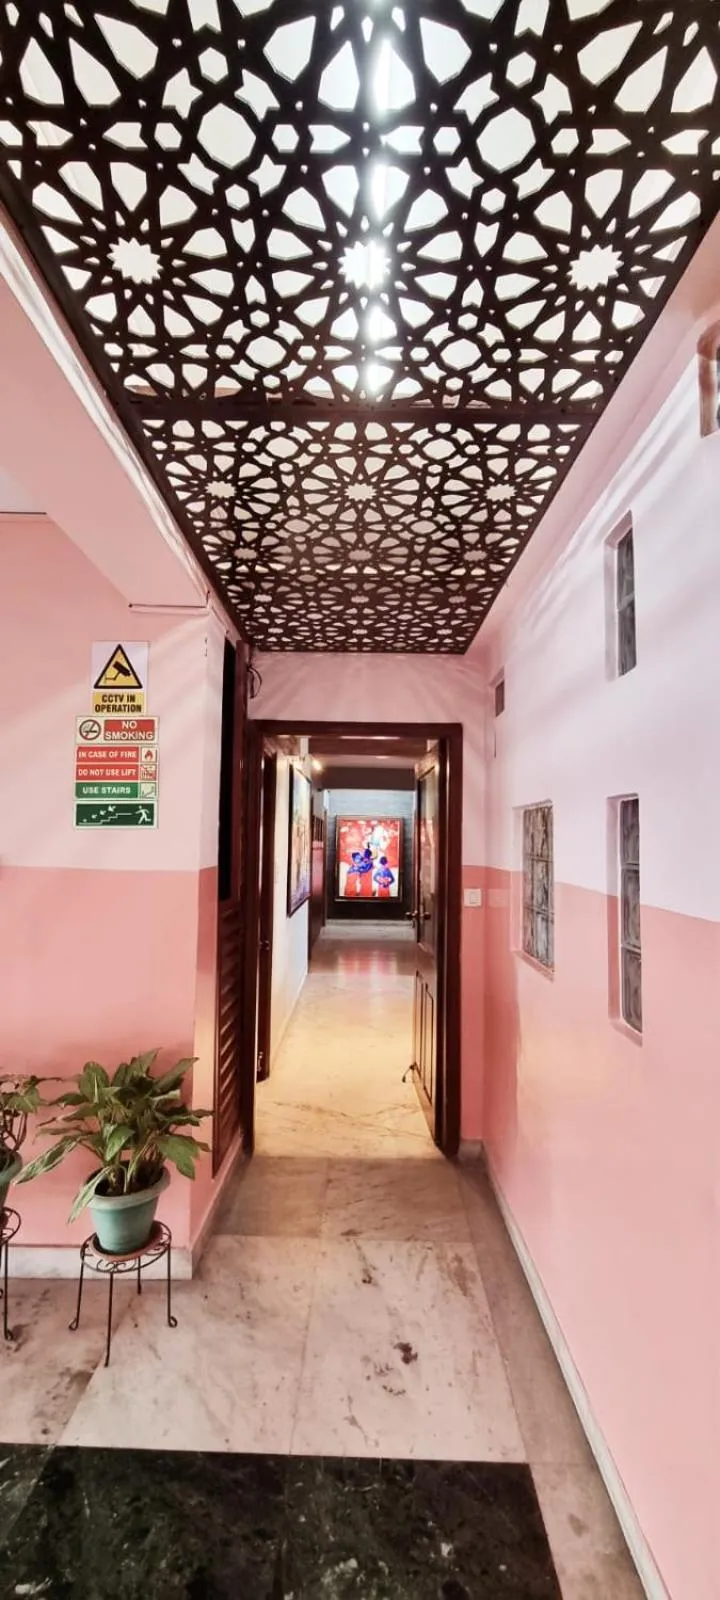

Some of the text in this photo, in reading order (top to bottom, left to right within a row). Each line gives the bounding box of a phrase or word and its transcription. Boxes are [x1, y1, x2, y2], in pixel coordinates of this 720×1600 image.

[101, 694, 136, 703] CCTV IN
[95, 704, 142, 713] OPERATION
[121, 720, 137, 729] NO
[105, 731, 154, 740] SMOKING
[78, 750, 137, 758] IN CASE OF FIRE
[78, 768, 137, 777] DO NOT USE LIFT
[82, 786, 131, 794] USE STAIRS
